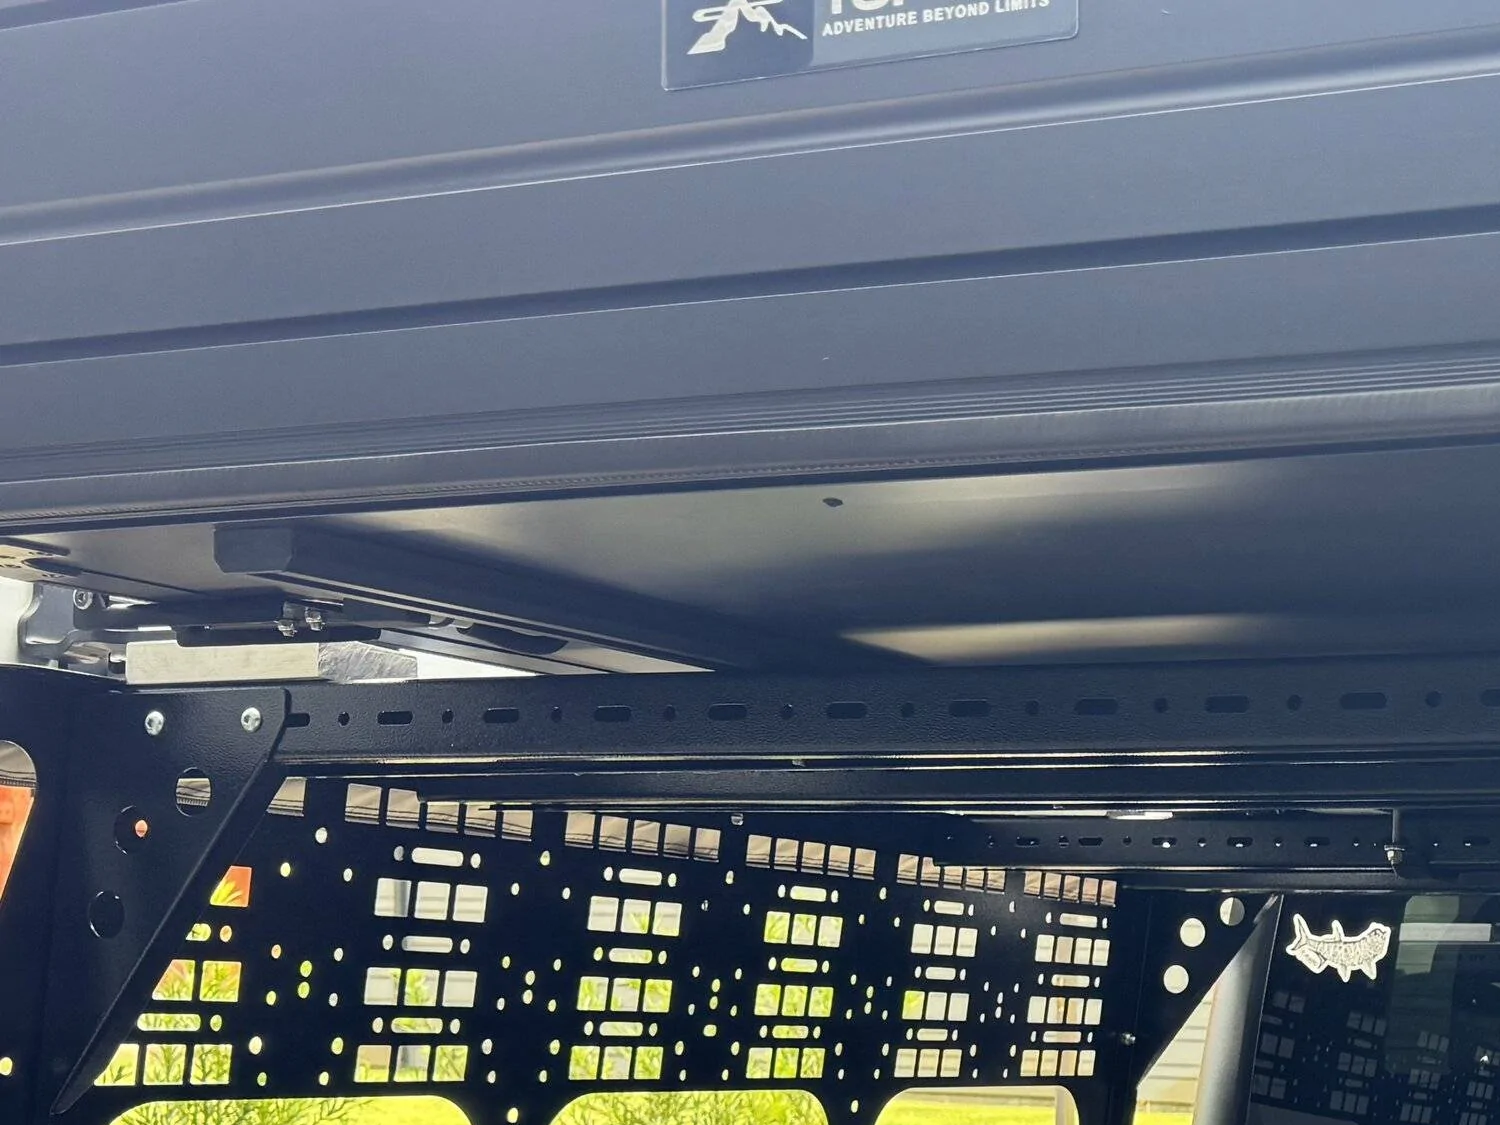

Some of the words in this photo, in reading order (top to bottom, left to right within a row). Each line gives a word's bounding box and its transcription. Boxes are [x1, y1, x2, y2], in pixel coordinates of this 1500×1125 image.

[822, 11, 918, 37] ADVENTURE
[922, 2, 990, 23] BEYOND
[994, 0, 1050, 13] LIMITS
